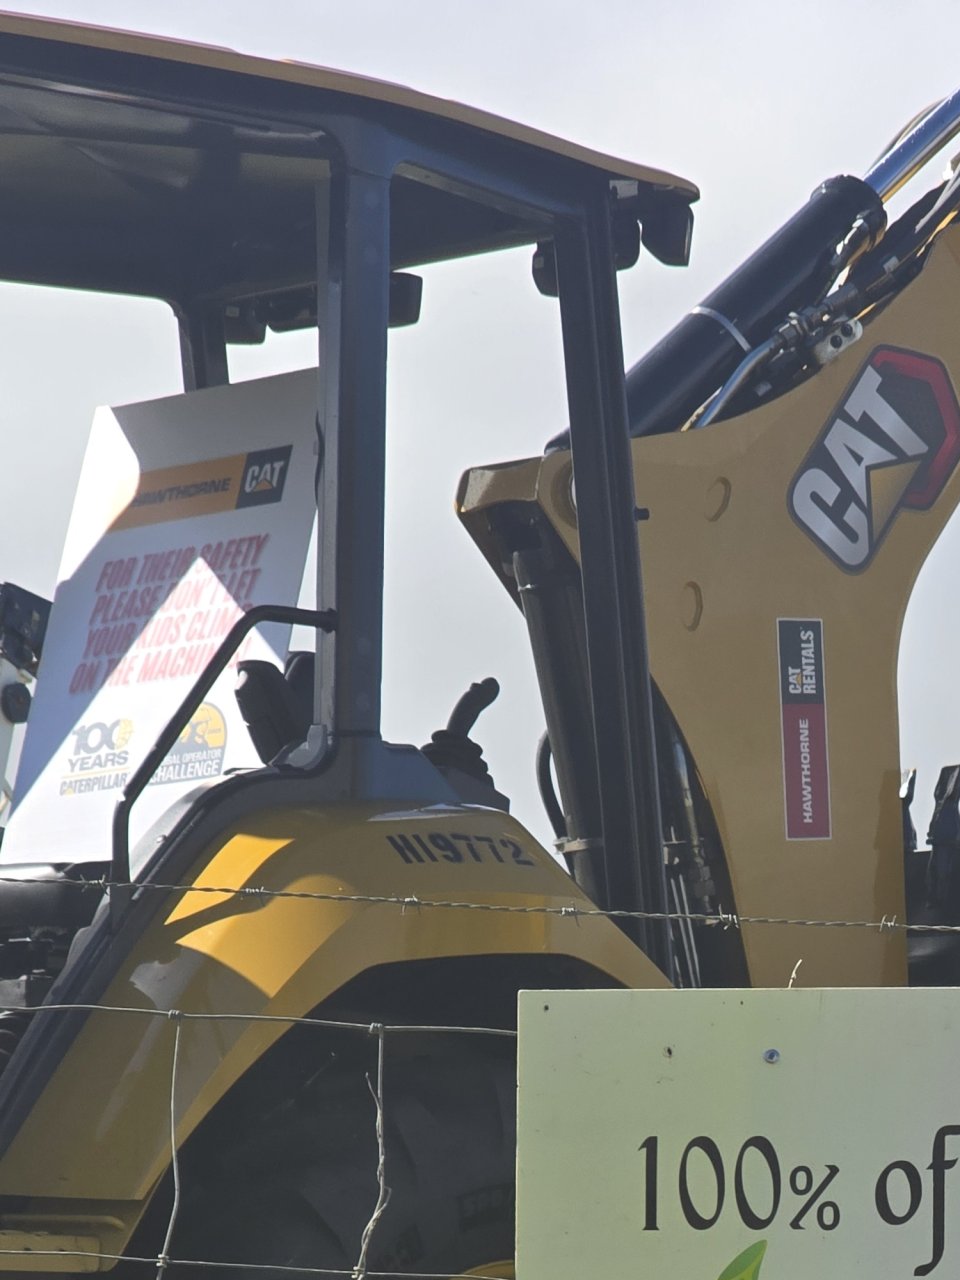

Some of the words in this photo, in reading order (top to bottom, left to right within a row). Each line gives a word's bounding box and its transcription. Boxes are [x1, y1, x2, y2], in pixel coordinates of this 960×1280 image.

[244, 461, 284, 493] CAT
[791, 364, 929, 567] CAT
[131, 477, 231, 507] AWTHORNE
[95, 557, 137, 592] FOR
[136, 545, 196, 585] THEIR
[195, 533, 269, 572] SAFETY
[89, 585, 163, 625] PLEASE
[160, 571, 226, 613] DON'T
[222, 569, 261, 604] LET
[82, 623, 137, 659] YOUR
[135, 612, 185, 650] KIDS
[185, 603, 253, 637] CLIM
[69, 663, 99, 694] ON
[100, 654, 138, 687] THE
[788, 666, 802, 694] CAT
[801, 630, 816, 694] RENTALS
[72, 718, 135, 755] 100
[68, 750, 129, 772] YEARS
[182, 749, 222, 764] OPERATOR
[799, 719, 813, 823] HAWTHORNE
[59, 773, 127, 796] CATERPILLAR
[386, 832, 534, 866] H19772
[637, 1135, 841, 1231] 100%
